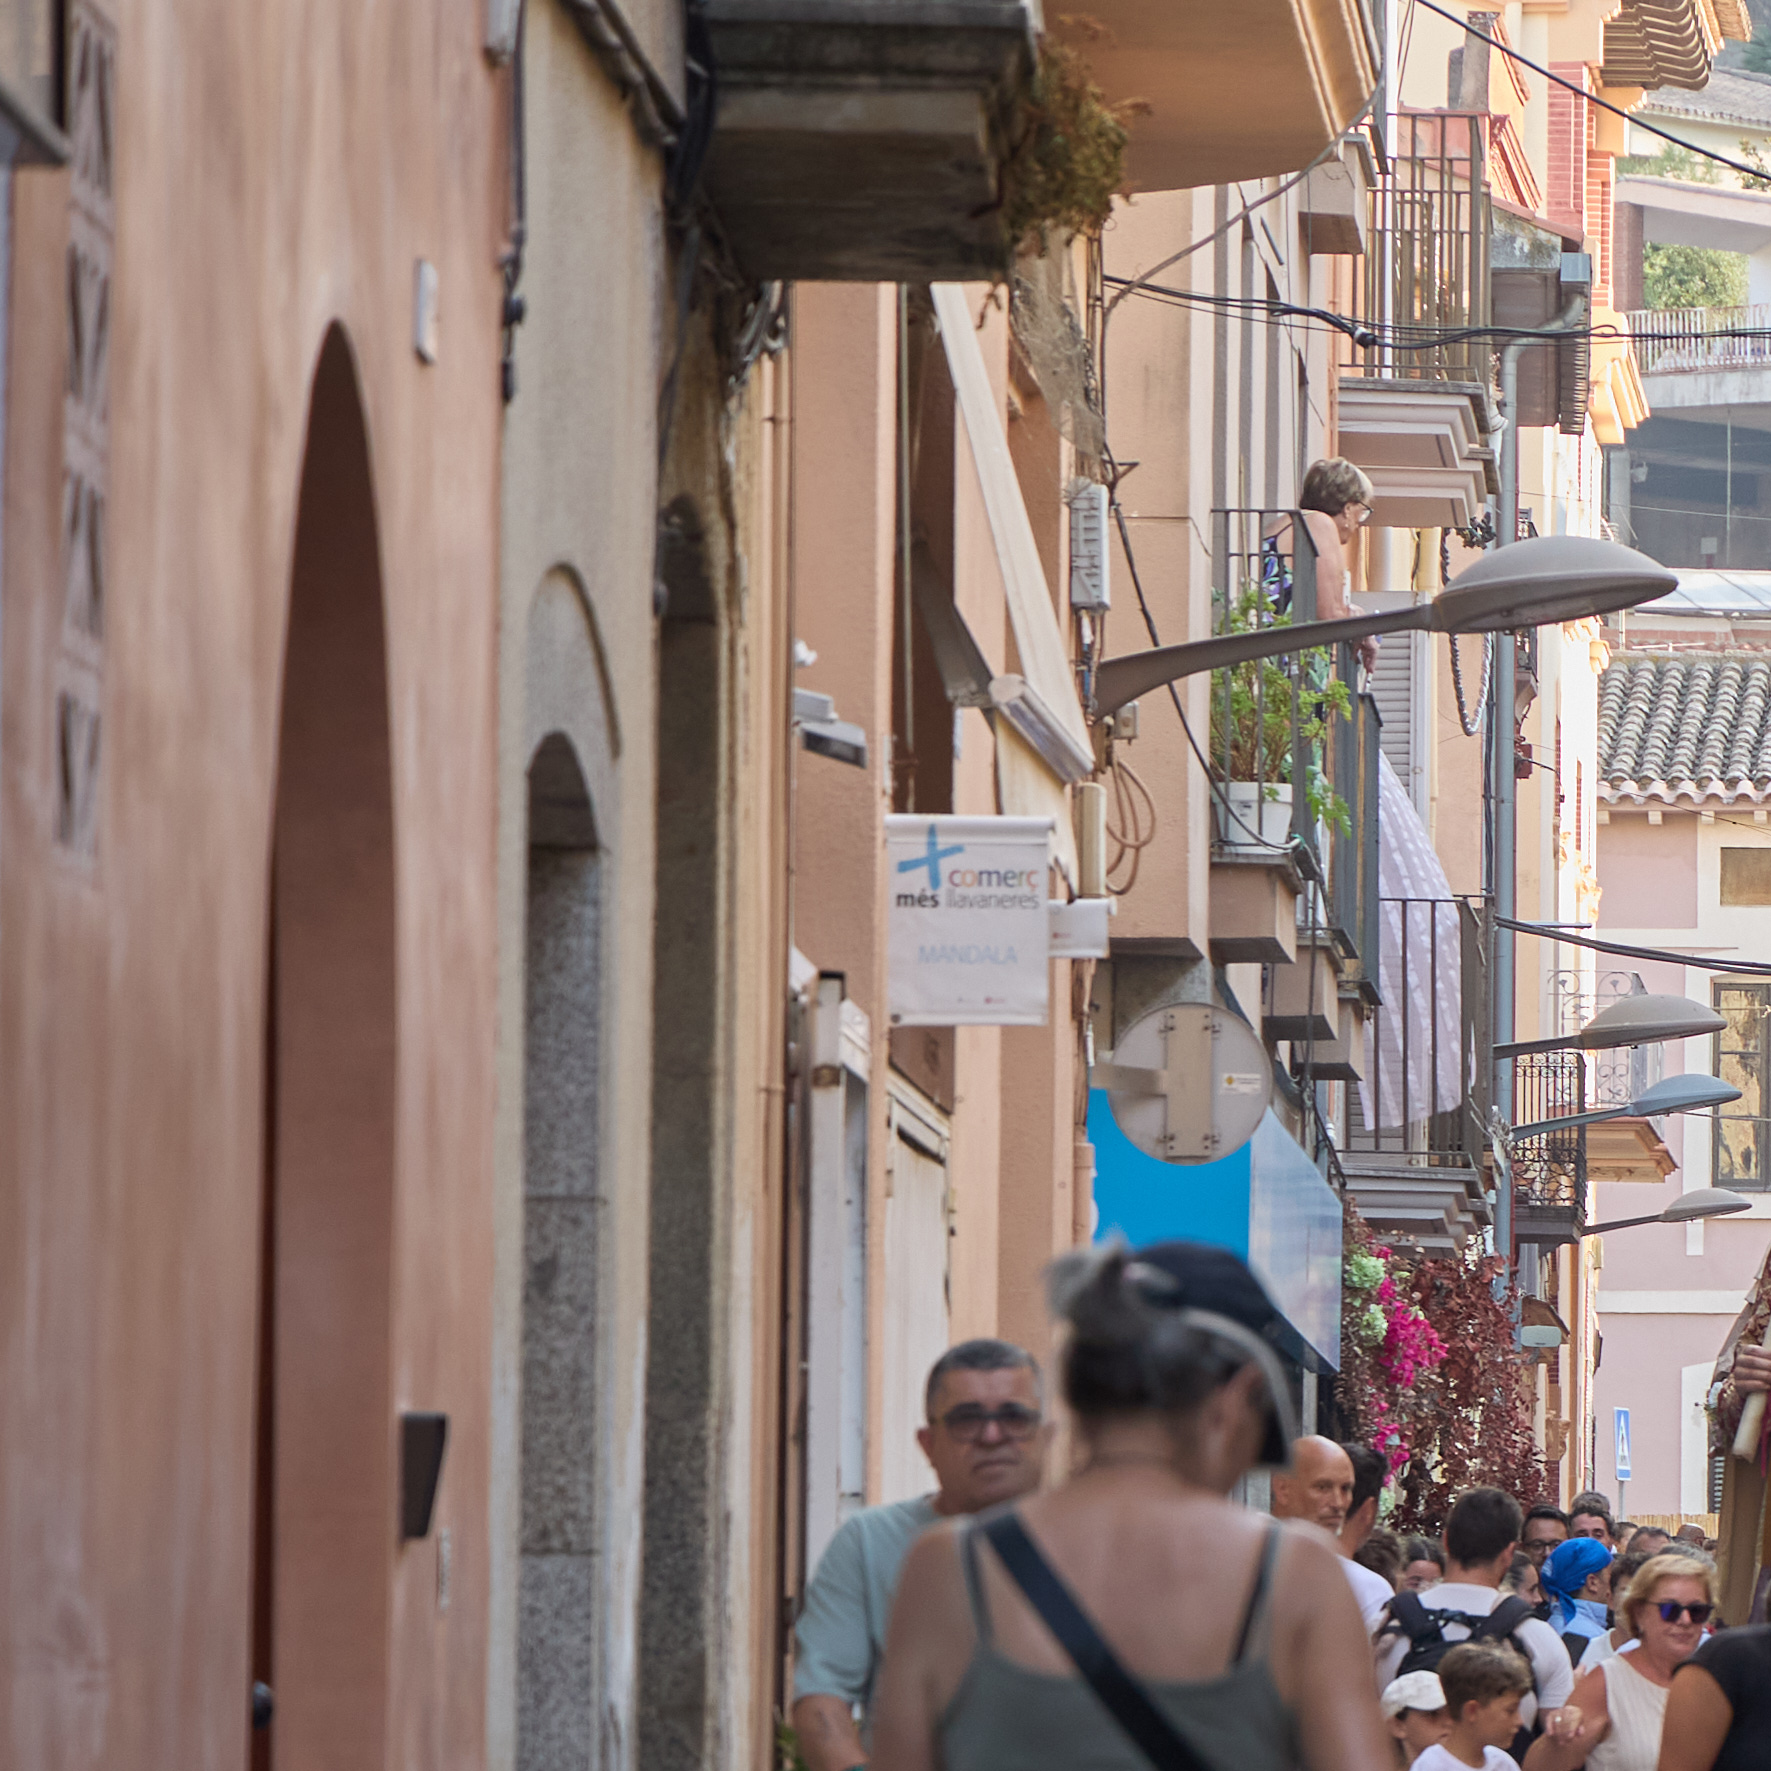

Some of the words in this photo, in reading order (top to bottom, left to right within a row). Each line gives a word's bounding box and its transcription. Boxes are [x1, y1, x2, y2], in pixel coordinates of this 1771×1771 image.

[948, 870, 1039, 892] comerç
[896, 888, 939, 908] més
[945, 888, 1040, 909] llavaneres
[918, 946, 1018, 965] MANDALA
